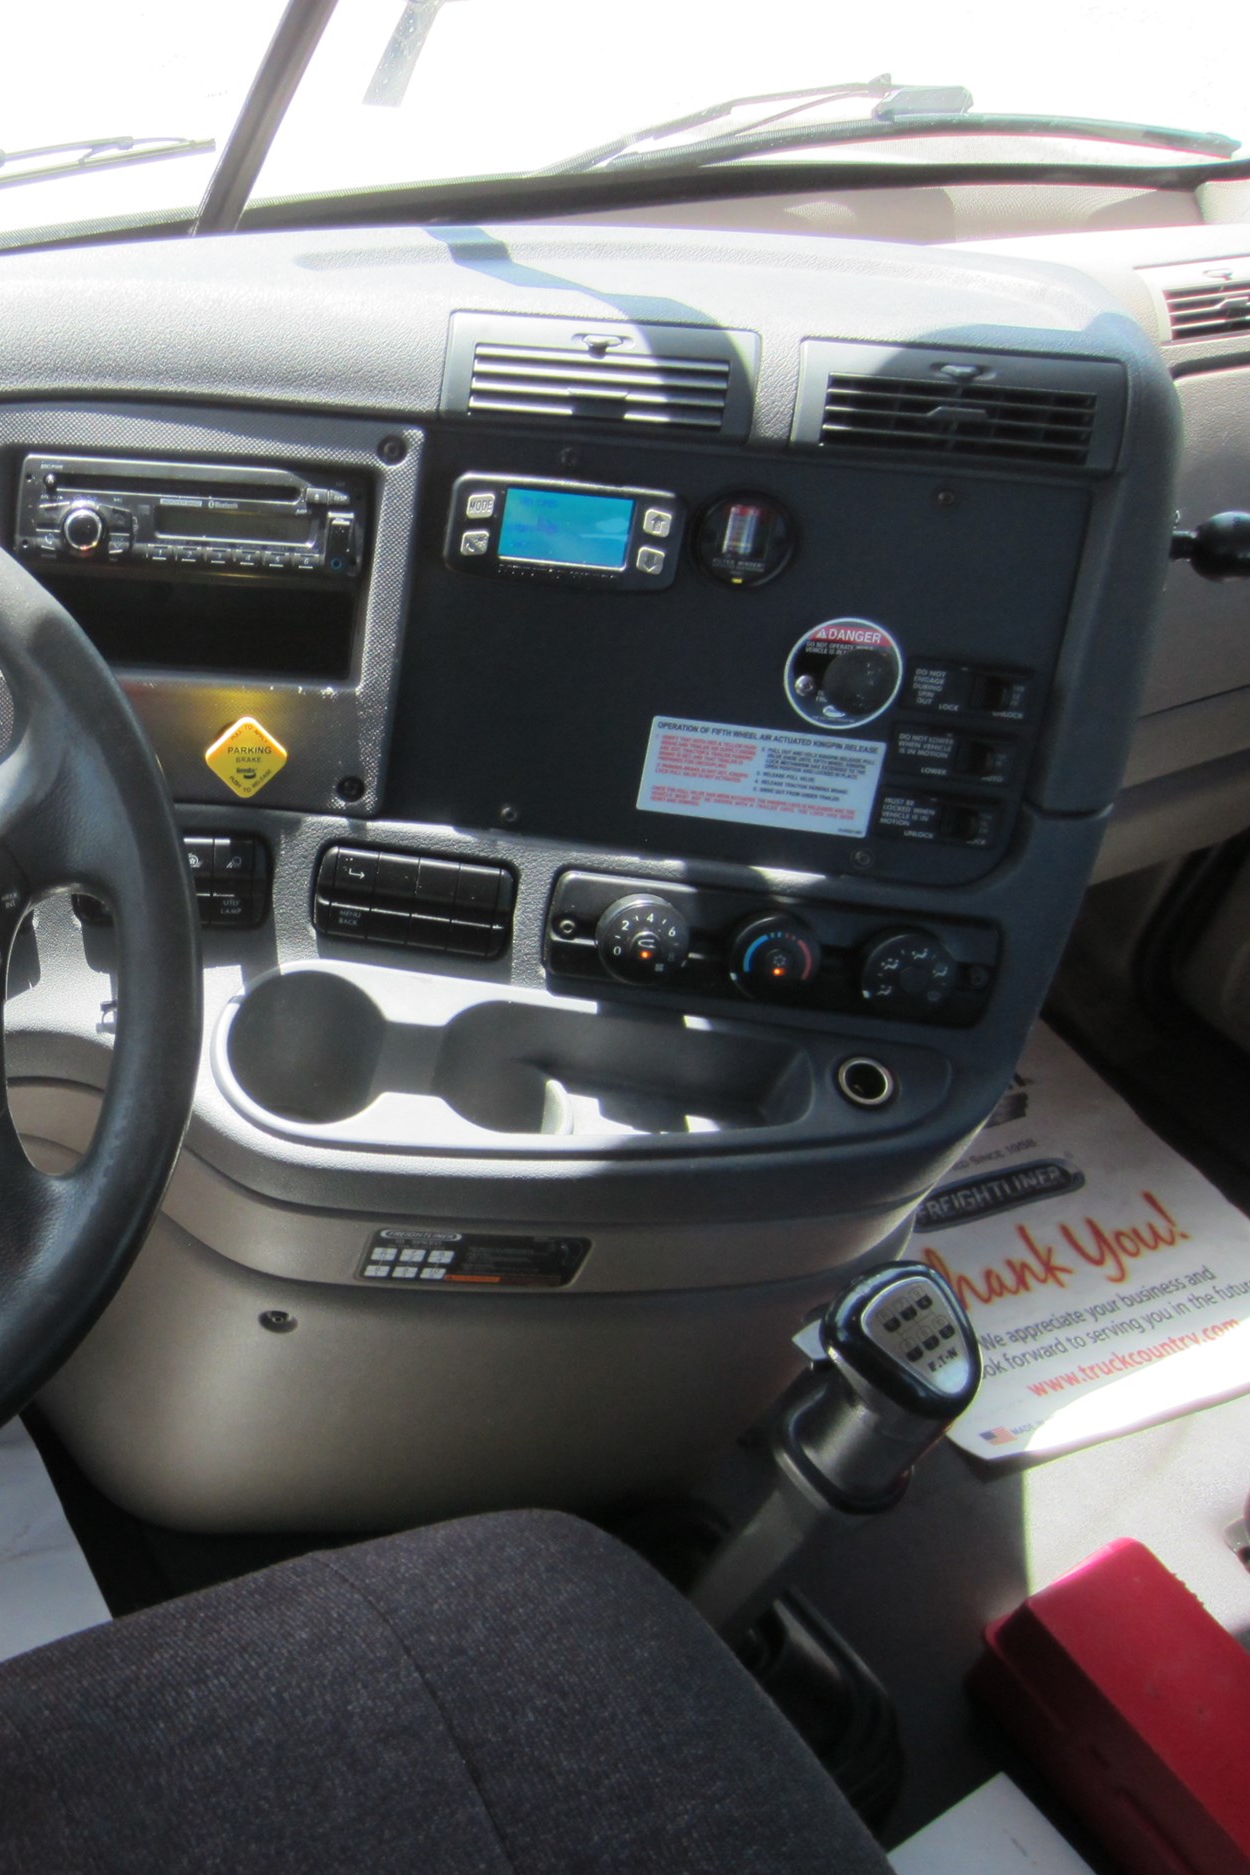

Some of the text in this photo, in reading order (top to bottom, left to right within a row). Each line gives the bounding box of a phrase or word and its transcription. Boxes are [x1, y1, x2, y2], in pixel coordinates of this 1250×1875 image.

[468, 499, 494, 514] MODE
[828, 628, 882, 644] DANGER
[913, 676, 945, 685] ENGAGE
[913, 683, 942, 691] DURING
[938, 703, 959, 711] LOCK
[657, 721, 879, 754] OPERATION OF FIFTH WHEEL AIR ACTUATED KINGPIN RELEASE
[227, 746, 272, 755] PARKING
[923, 744, 952, 752] VEHICLE
[917, 750, 949, 759] MOTION
[920, 767, 947, 775] LOWER
[881, 811, 909, 819] VEHICLE
[880, 818, 909, 826] MOTION
[903, 830, 934, 839] UNLOCK
[339, 909, 361, 918] MENU
[646, 913, 654, 923] 4
[338, 918, 358, 926] BACK
[621, 920, 630, 931] 2
[668, 926, 676, 937] 6
[613, 946, 622, 955] 0
[969, 1151, 1004, 1165] SINCE
[1005, 1138, 1037, 1155] 1958
[923, 1189, 1191, 1310] hank You!
[978, 1264, 1218, 1351] We appreciate your business and
[1005, 1337, 1069, 1369] forward
[1068, 1333, 1087, 1349] to
[1085, 1315, 1147, 1345] serving
[1143, 1307, 1174, 1330] you
[1171, 1298, 1191, 1317] in
[1187, 1288, 1219, 1312] the
[1026, 1316, 1242, 1398] www.truckcountry.com
